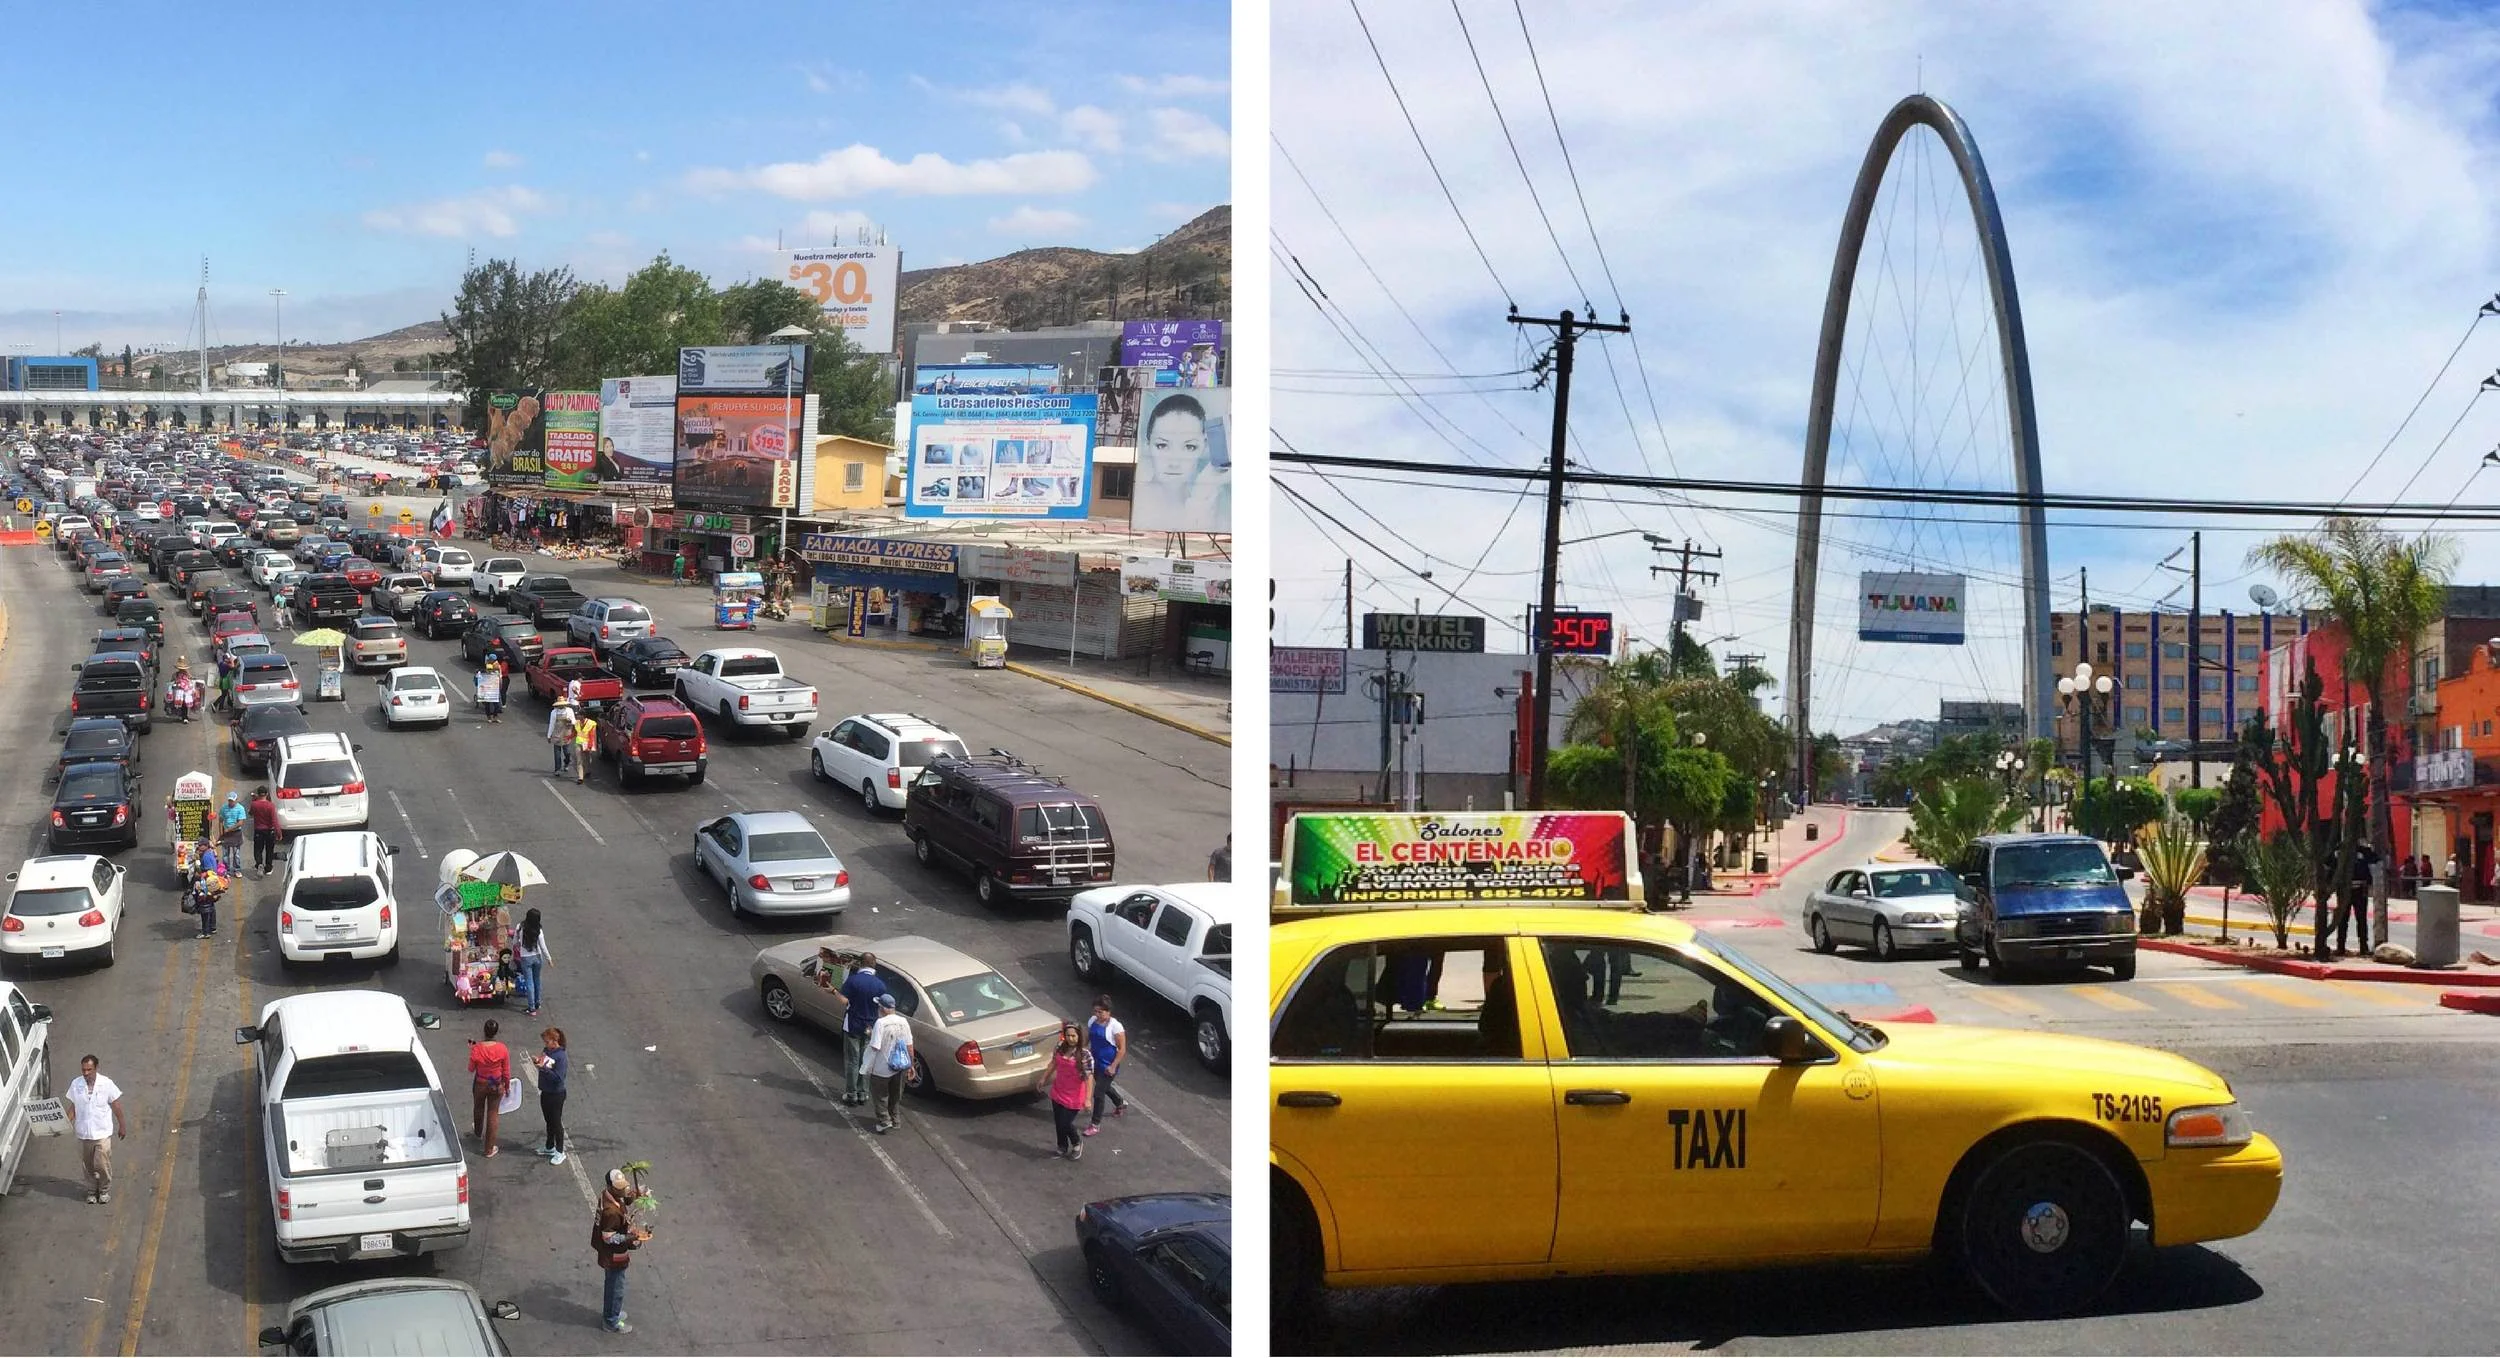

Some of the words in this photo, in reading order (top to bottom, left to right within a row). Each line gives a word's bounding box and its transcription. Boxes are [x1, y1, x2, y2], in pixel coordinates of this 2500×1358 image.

[825, 252, 848, 261] mejor
[544, 393, 565, 411] AUTO
[566, 393, 600, 412] PARKING
[938, 397, 1070, 409] LaCasadelosPies.com
[547, 448, 593, 462] GRATIS
[512, 457, 544, 473] BRASIL
[805, 535, 880, 555] FARMACIA
[884, 541, 952, 560] EXPRESS
[1867, 593, 1958, 612] TIJUANA
[1377, 615, 1473, 636] MOTEL
[1378, 633, 1472, 650] PARKING
[1421, 822, 1504, 841] Salones
[1356, 843, 1384, 862] EL
[1390, 839, 1572, 862] CENTENARIO
[1357, 881, 1468, 890] EVENTOS
[1474, 879, 1585, 888] SOCIALES
[1343, 889, 1474, 901] INFORMES:
[23, 1100, 61, 1113] FARMACIA
[2091, 1092, 2163, 1123] TS-2195
[30, 1111, 64, 1123] EXPRESS
[1667, 1108, 1746, 1170] TAXI
